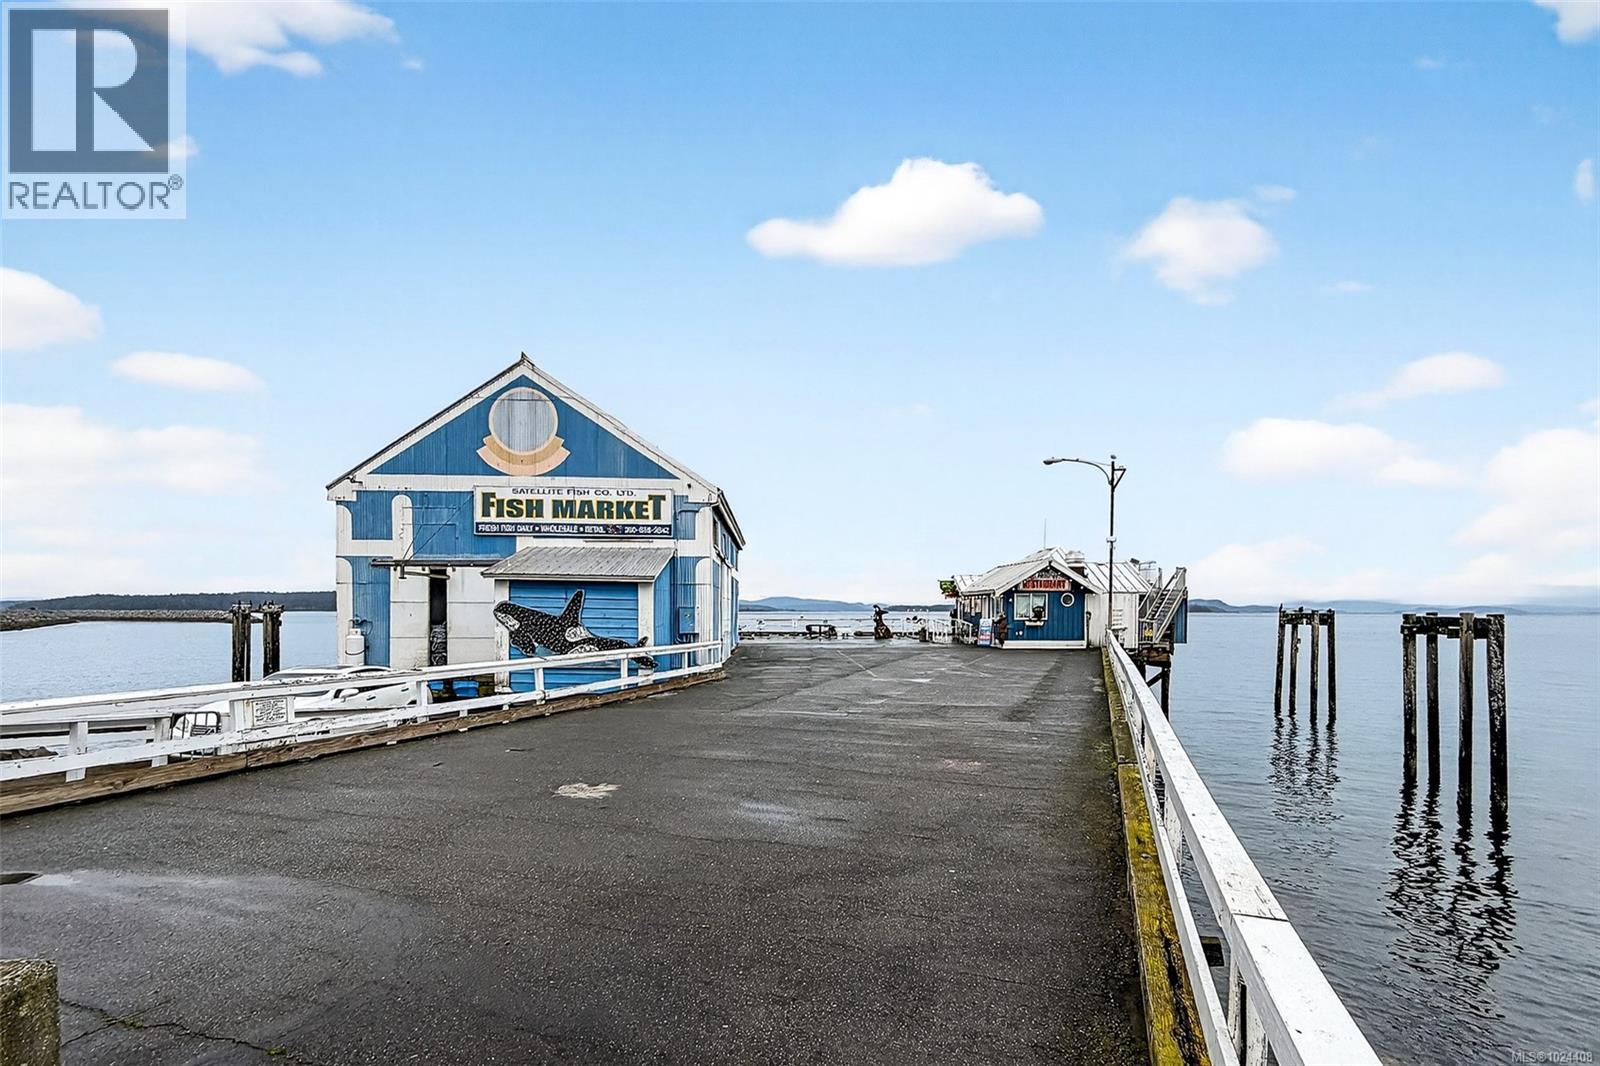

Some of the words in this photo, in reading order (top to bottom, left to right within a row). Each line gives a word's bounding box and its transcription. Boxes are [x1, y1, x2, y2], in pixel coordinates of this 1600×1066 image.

[594, 489, 612, 497] CO.
[481, 492, 544, 518] FISH
[551, 494, 666, 520] MARKET
